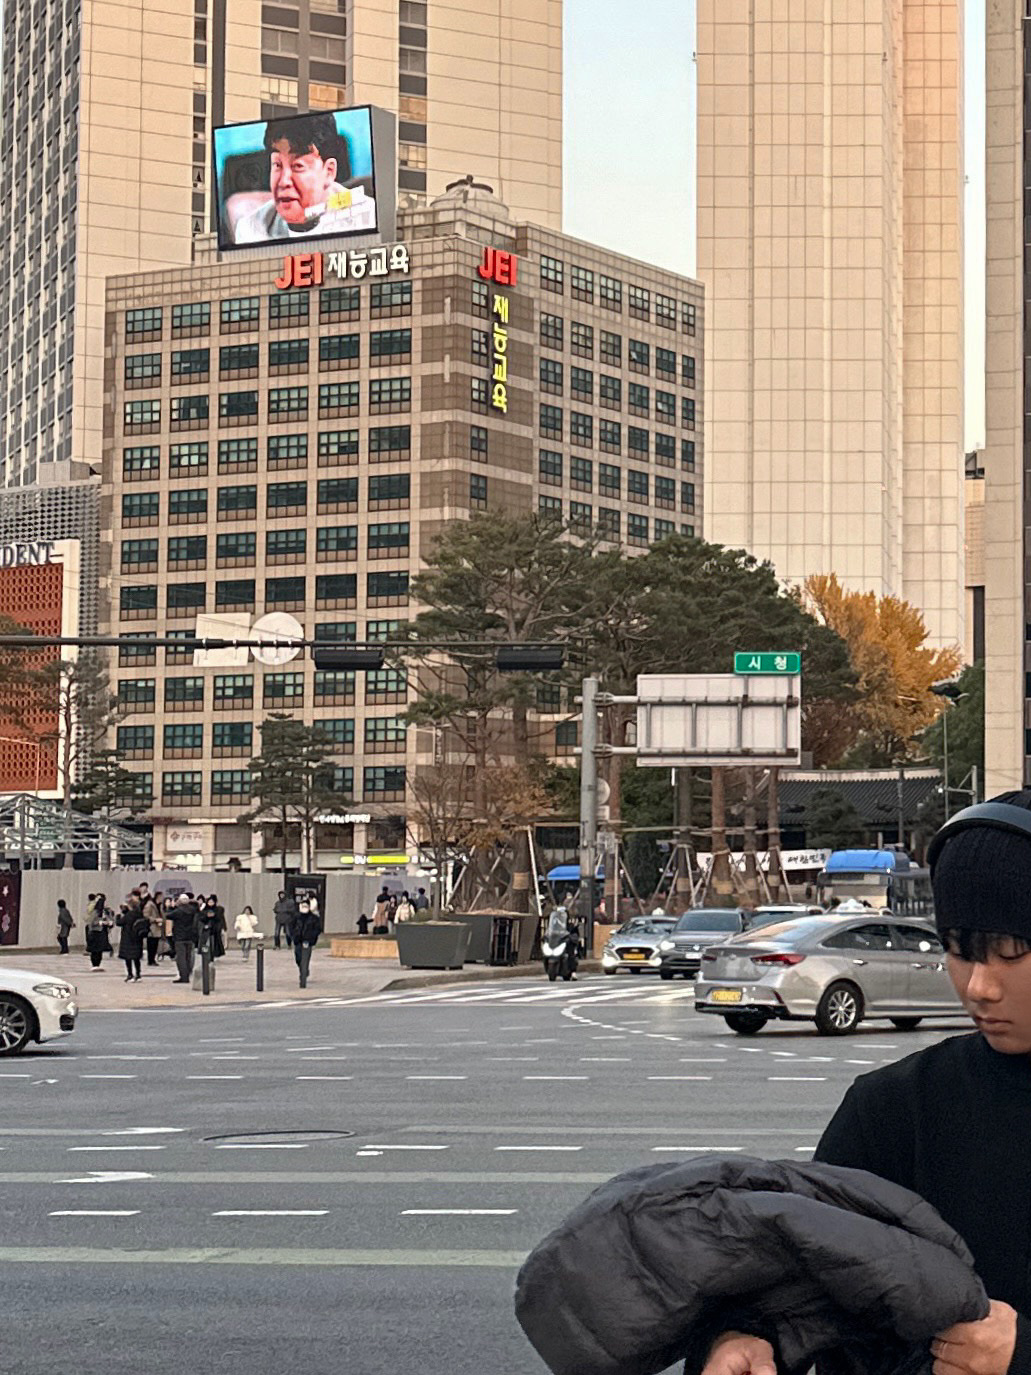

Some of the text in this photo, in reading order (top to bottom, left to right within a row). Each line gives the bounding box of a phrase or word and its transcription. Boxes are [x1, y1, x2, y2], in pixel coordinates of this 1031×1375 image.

[274, 244, 410, 290] JEI 재능교육
[478, 246, 517, 287] JEI
[492, 294, 509, 413] 재능교육
[2, 541, 55, 568] DENT
